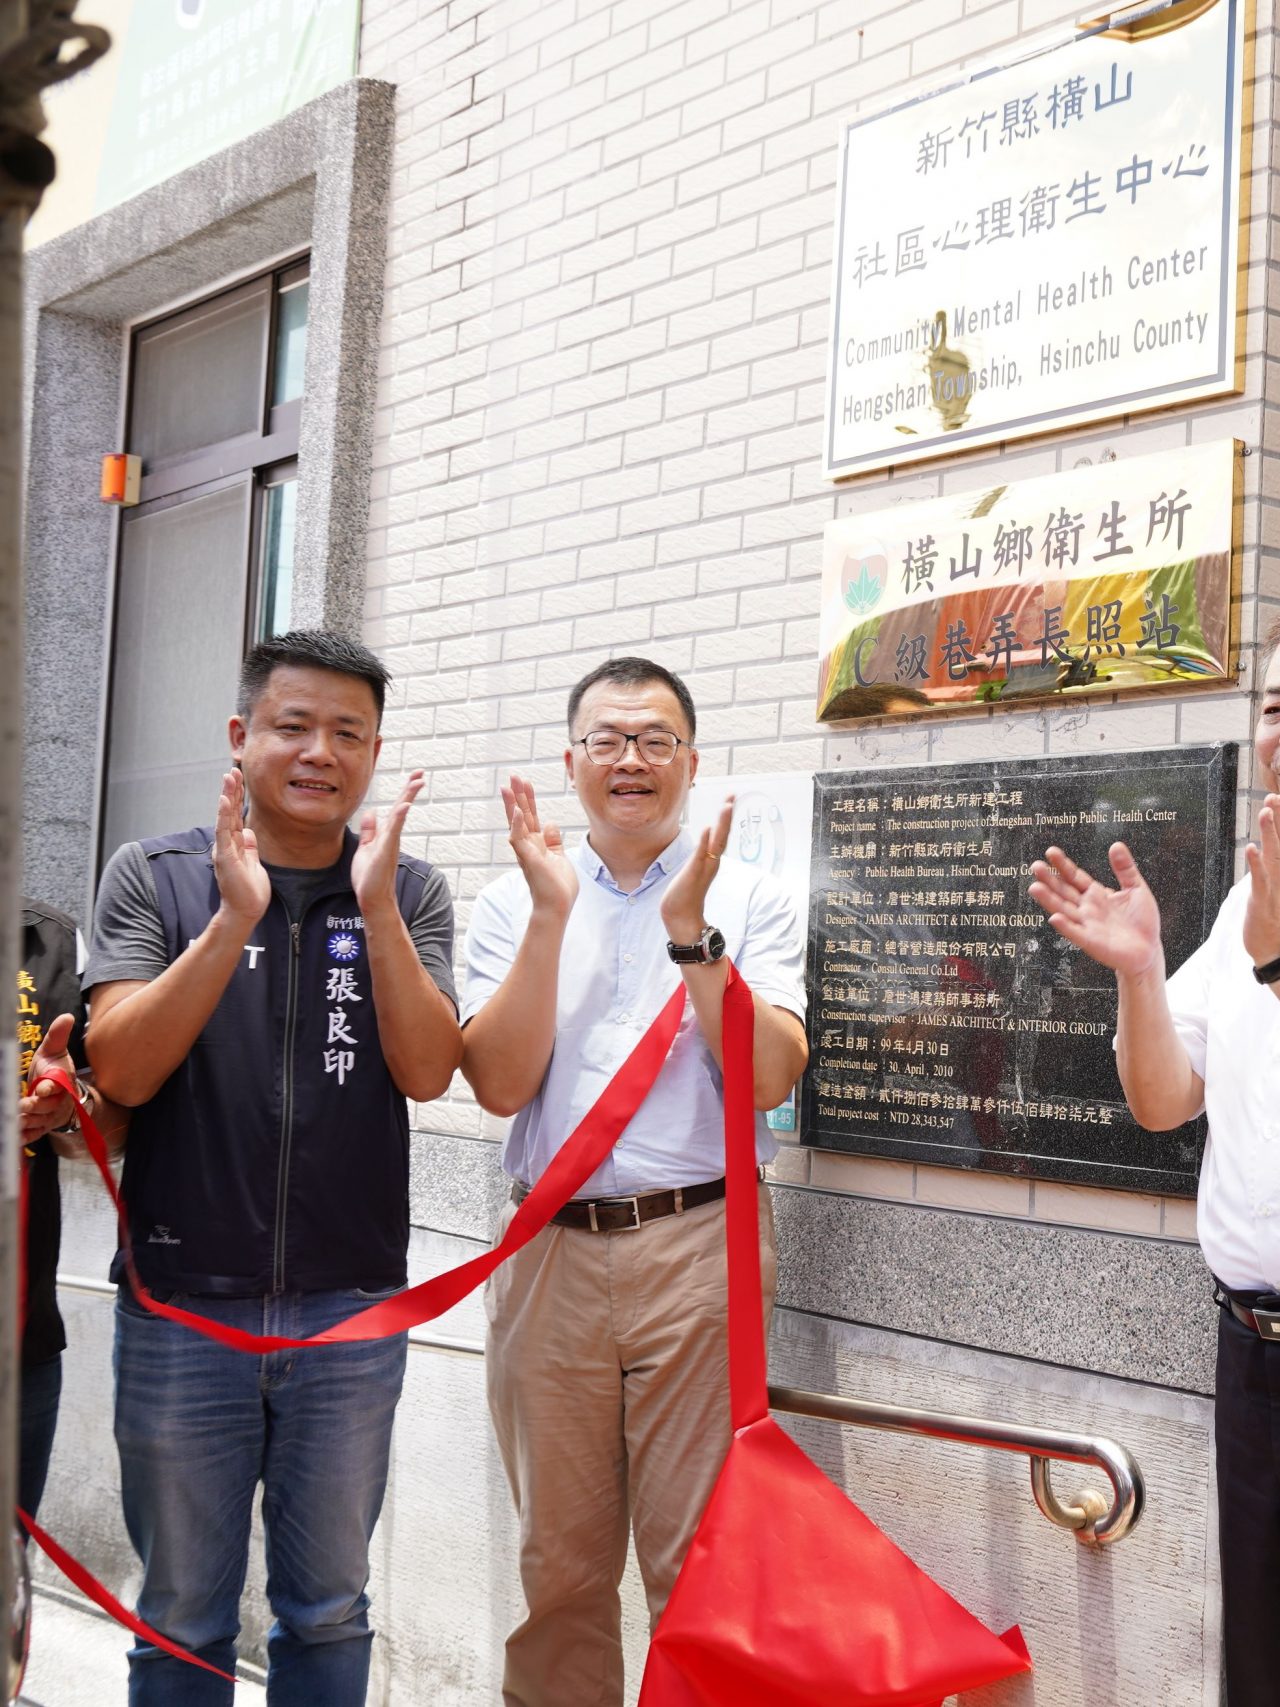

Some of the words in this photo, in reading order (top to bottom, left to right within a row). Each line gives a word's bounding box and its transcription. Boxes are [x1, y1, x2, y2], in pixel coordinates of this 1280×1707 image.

[916, 62, 1133, 175] 新竹縣橫山
[853, 144, 1210, 289] 社區心理衛生中心
[846, 319, 942, 367] Community
[954, 290, 1020, 338] Mental
[1037, 265, 1113, 316] Health
[1127, 244, 1208, 288] Center
[843, 383, 926, 425] Hengshan
[935, 355, 1022, 402] Township,
[1040, 330, 1120, 376] Hsinchu
[1134, 311, 1208, 353] County
[901, 488, 1192, 596] 橫山鄉衛生所
[854, 593, 1182, 687] C級巷弄長照站
[830, 821, 854, 835] Project
[857, 823, 876, 832] name
[887, 819, 901, 831] The
[903, 818, 950, 830] construction
[951, 817, 979, 831] project
[1035, 812, 1077, 827] Township
[1079, 811, 1107, 824] Public
[1113, 809, 1143, 822] Health
[1145, 809, 1177, 822] Center
[865, 866, 889, 878] Public
[890, 866, 915, 877] Health
[951, 864, 986, 877] HsinChu
[988, 864, 1018, 879] County
[825, 913, 857, 929] Designer
[864, 914, 893, 926] JAMES
[897, 914, 948, 926] ARCHITECT
[950, 914, 958, 926] &
[960, 914, 1007, 927] INTERIOR
[1009, 914, 1045, 927] GROUP
[823, 960, 861, 973] Contractor
[871, 963, 897, 975] Consul
[899, 964, 929, 976] General
[323, 967, 363, 1086] 張良印
[821, 1008, 866, 1022] Construction
[868, 1013, 906, 1025] supervisor
[917, 1014, 947, 1027] JAMES
[950, 1015, 1006, 1030] ARCHITECT
[1007, 1018, 1016, 1031] &
[1018, 1018, 1067, 1034] INTERIOR
[1069, 1021, 1107, 1036] GROUP
[819, 1055, 860, 1071] Completion
[862, 1059, 878, 1071] date
[933, 1064, 954, 1077] 2010
[817, 1103, 836, 1116] Total
[837, 1107, 864, 1120] project
[865, 1109, 879, 1120] cost
[889, 1111, 909, 1124] NTD
[910, 1113, 954, 1129] 28,343,547
